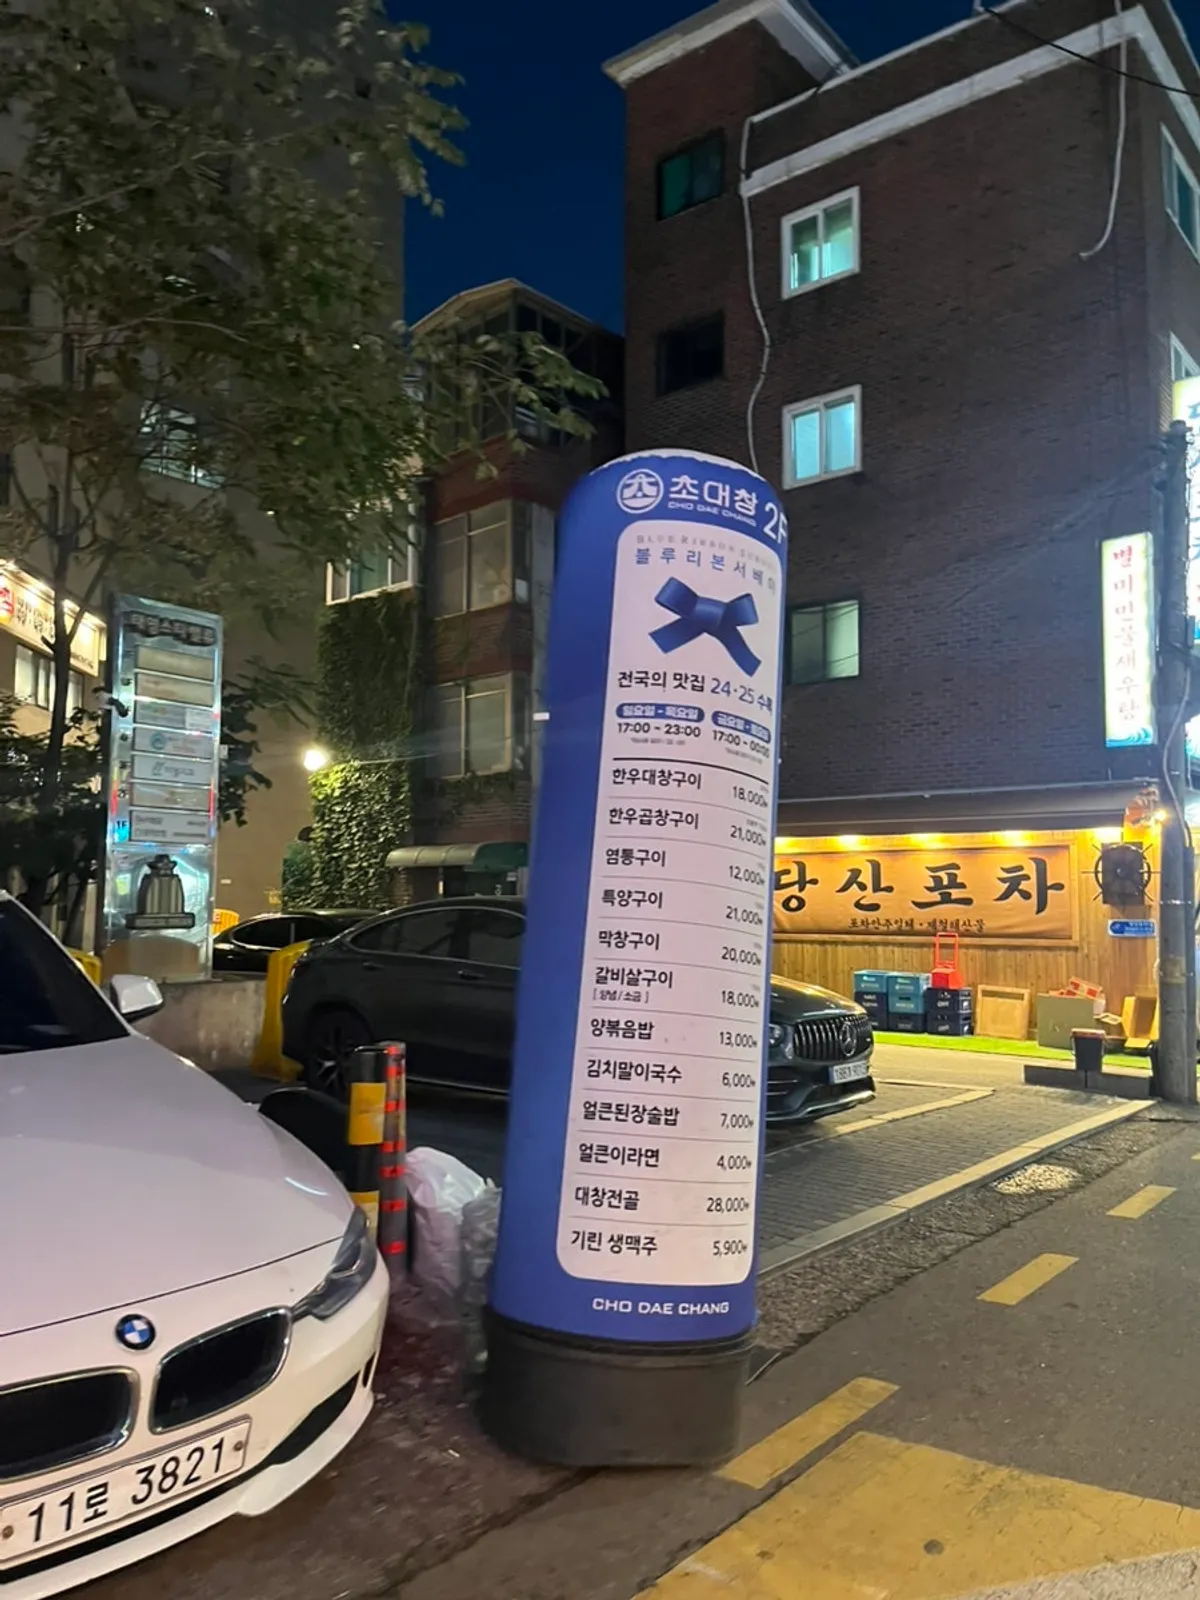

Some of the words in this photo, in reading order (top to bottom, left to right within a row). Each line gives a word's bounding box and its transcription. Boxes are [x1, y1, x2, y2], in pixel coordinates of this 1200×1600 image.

[669, 474, 758, 516] 초대창
[668, 501, 694, 511] CHO
[697, 504, 719, 515] DAE
[763, 501, 788, 544] 2F
[618, 671, 667, 688] 전국의
[673, 674, 705, 692] 맛집
[617, 722, 651, 735] 17:00
[664, 723, 701, 738] 23:00
[712, 729, 742, 747] 17:00
[612, 768, 702, 790] 한우대창구이
[608, 807, 699, 830] 한우곱창구이
[605, 848, 666, 868] 염통구이
[774, 857, 1066, 916] 당산포차
[601, 889, 663, 909] 특양구이
[598, 930, 660, 951] 막창구이
[595, 966, 673, 989] 갈비살구이
[590, 1018, 655, 1041] 양볶음밥
[586, 1058, 683, 1084] 김치말이국수
[582, 1100, 680, 1127] 얼큰된장술밥
[578, 1143, 660, 1168] 얼큰이라면
[574, 1186, 640, 1211] 대창전골
[570, 1230, 602, 1252] 기린
[607, 1234, 658, 1256] 생맥주
[592, 1298, 633, 1313] CHO
[638, 1301, 674, 1315] DAE
[678, 1301, 730, 1315] CHANG
[28, 1481, 109, 1542] 11로
[131, 1437, 225, 1506] 3821
